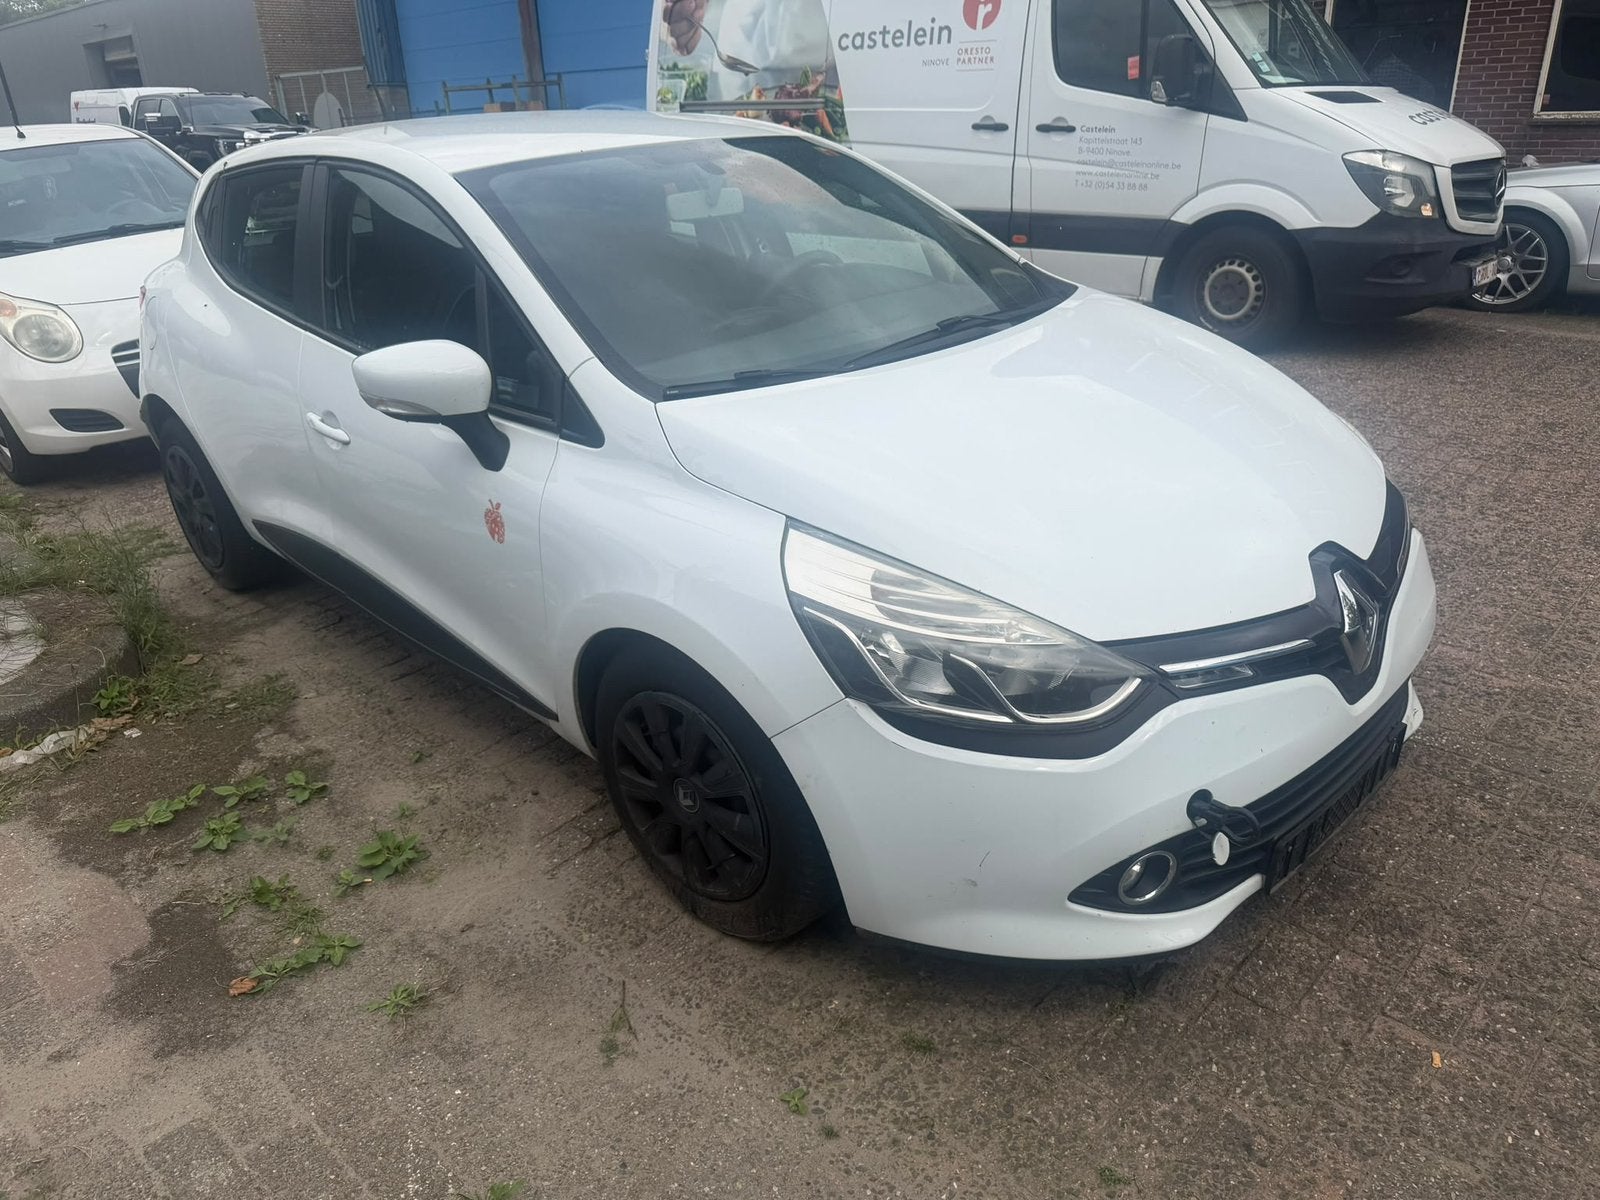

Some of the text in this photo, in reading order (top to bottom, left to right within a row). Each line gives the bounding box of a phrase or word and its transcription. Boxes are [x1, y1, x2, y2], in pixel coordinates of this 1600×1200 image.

[837, 16, 952, 51] castelein
[957, 46, 991, 56] ORESTO
[921, 57, 950, 67] NINOVE
[956, 55, 995, 66] PARTNER
[1080, 125, 1116, 134] Castelein
